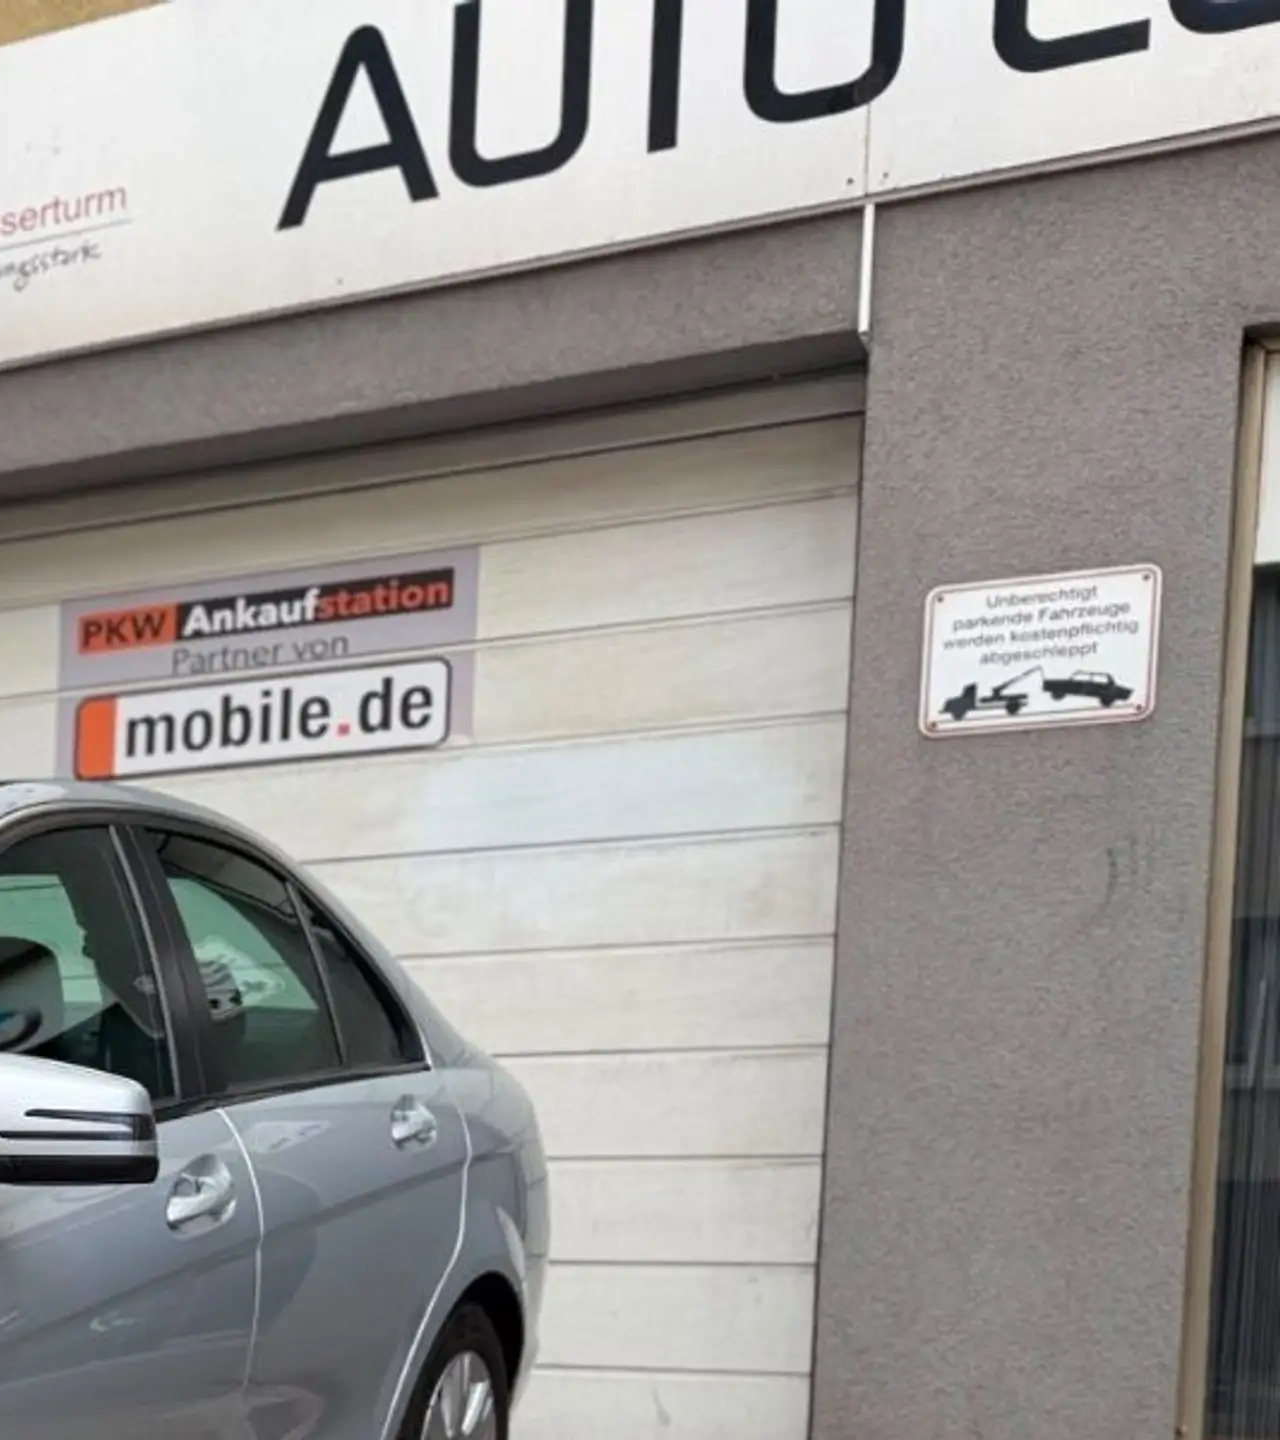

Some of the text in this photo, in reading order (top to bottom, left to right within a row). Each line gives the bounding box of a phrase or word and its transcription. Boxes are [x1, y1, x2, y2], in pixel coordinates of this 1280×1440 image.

[81, 577, 450, 649] PKW Ankaufstation
[986, 585, 1099, 610] Unberechtigt
[952, 602, 1132, 633] parkende Fahrzeuge
[943, 619, 1140, 651] werden kostenpflichtig
[172, 633, 350, 677] Partner von
[980, 642, 1100, 666] abgeschleppt
[124, 676, 435, 759] mobile.de
